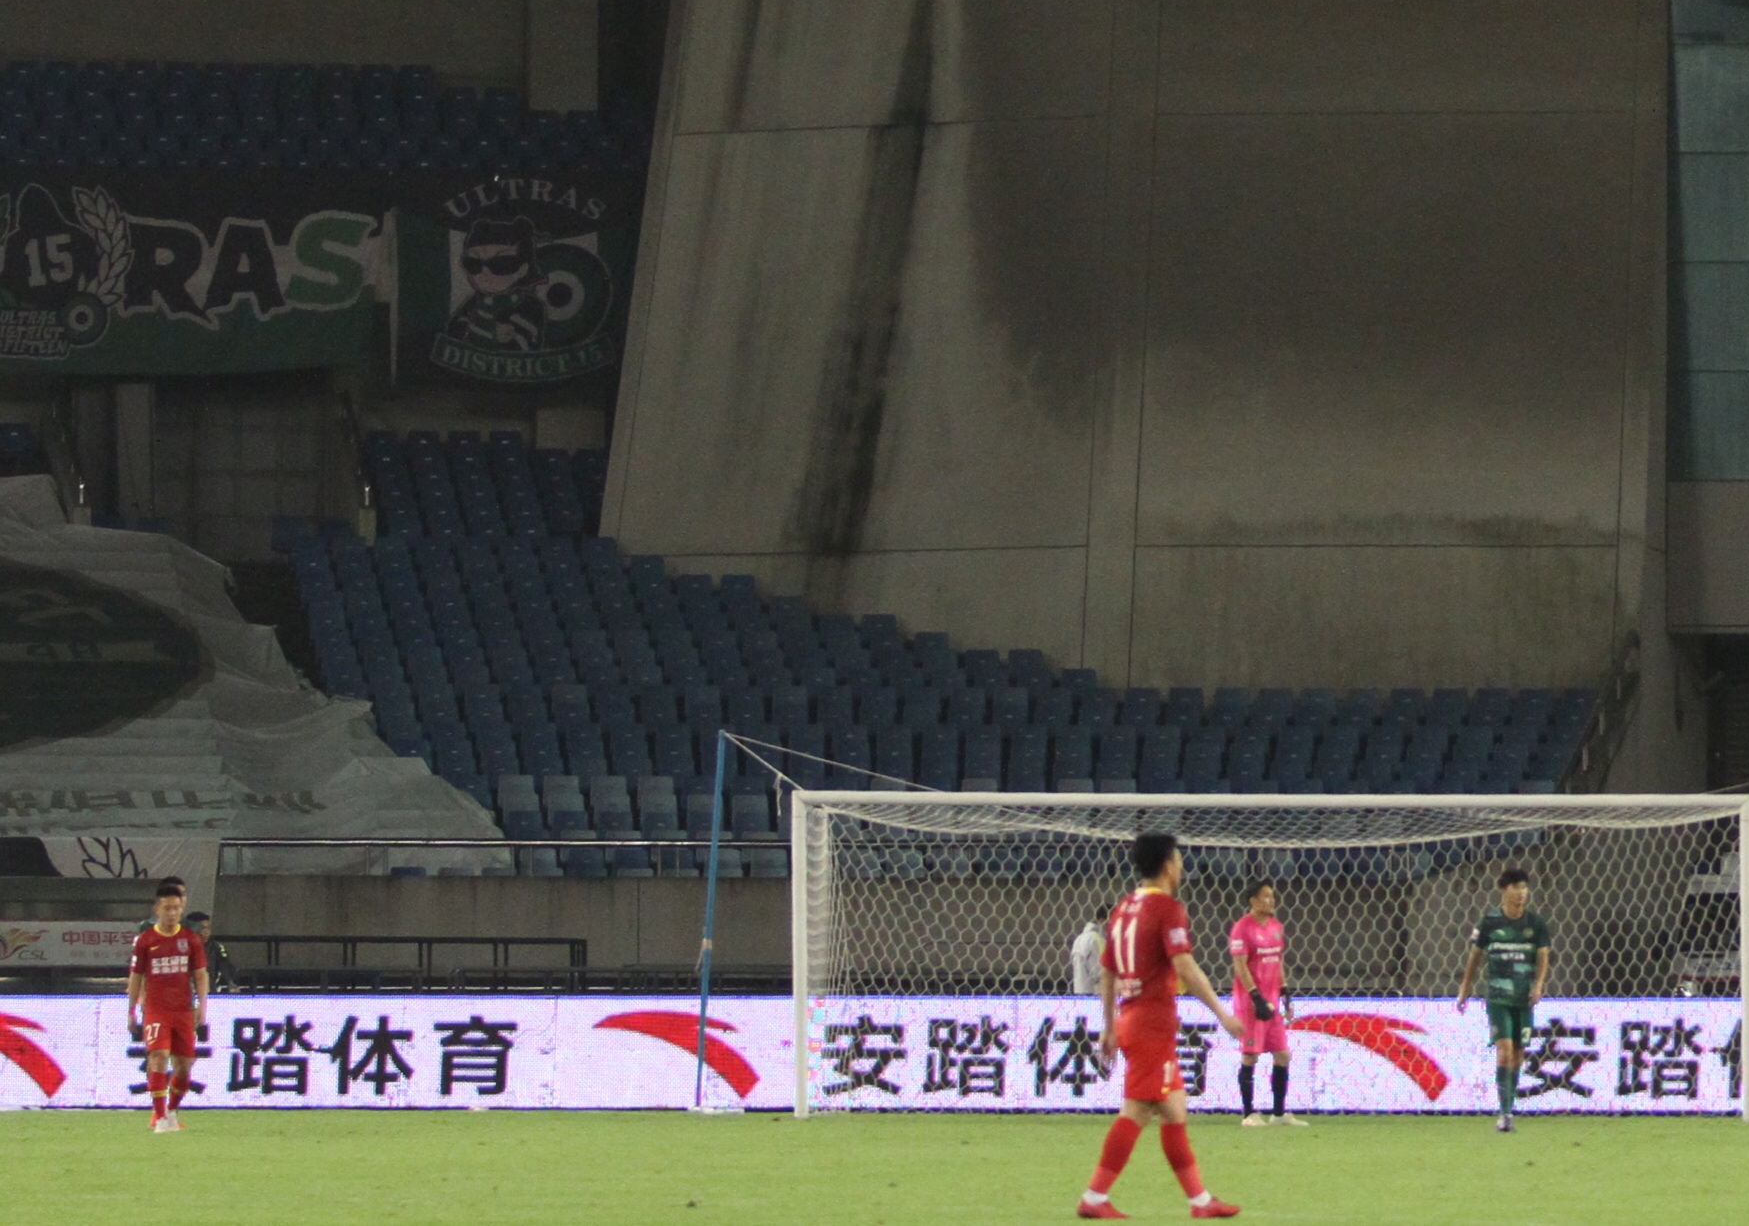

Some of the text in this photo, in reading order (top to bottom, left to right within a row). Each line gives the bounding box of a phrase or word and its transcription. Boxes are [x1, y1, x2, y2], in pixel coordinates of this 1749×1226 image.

[441, 178, 607, 219] ULTRAS
[24, 234, 74, 288] 15
[442, 344, 603, 376] DISTRICT 15
[18, 946, 48, 961] CSL
[62, 930, 138, 946] 中国平安
[1111, 917, 1138, 974] 11
[145, 1023, 161, 1041] 27
